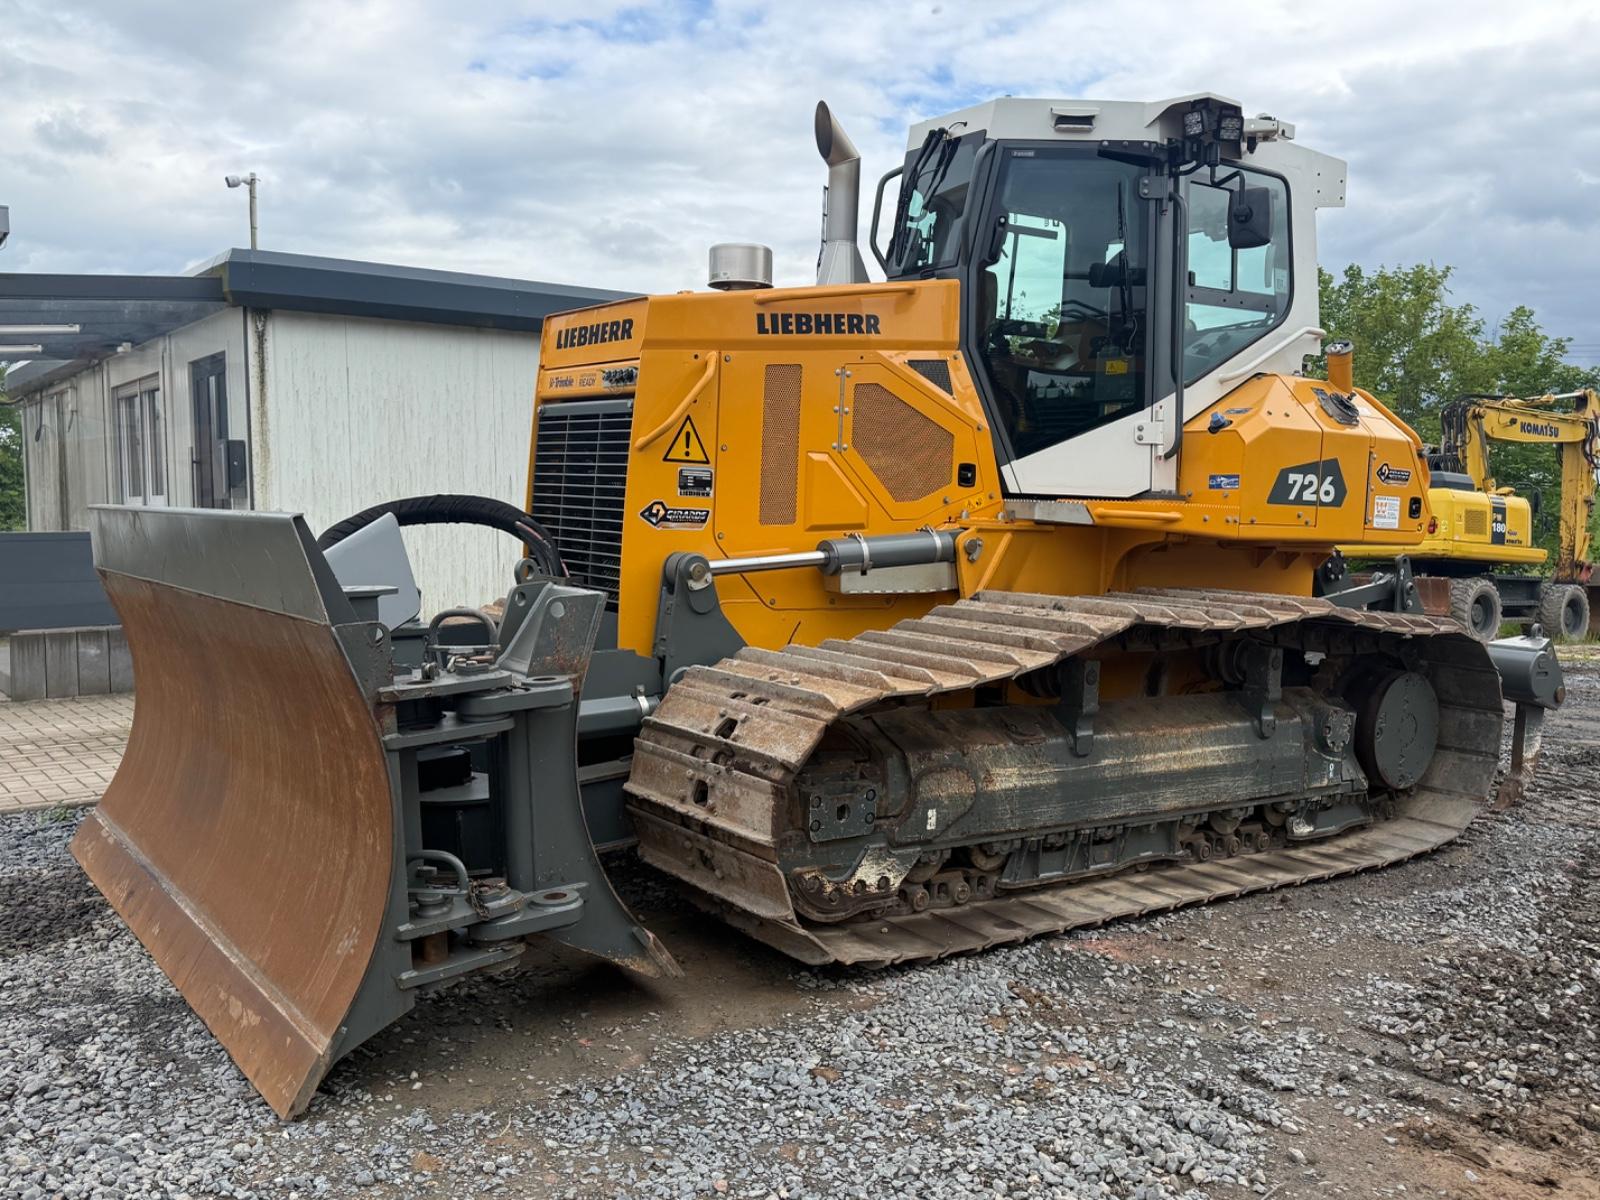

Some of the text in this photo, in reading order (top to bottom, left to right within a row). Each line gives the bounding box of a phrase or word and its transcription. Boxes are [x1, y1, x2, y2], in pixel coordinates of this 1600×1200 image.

[556, 318, 634, 350] LIEBHERR
[756, 313, 881, 335] LIEBHERR
[1520, 421, 1559, 438] KOMATSU
[1287, 473, 1336, 503] 726
[1492, 522, 1507, 533] 180
